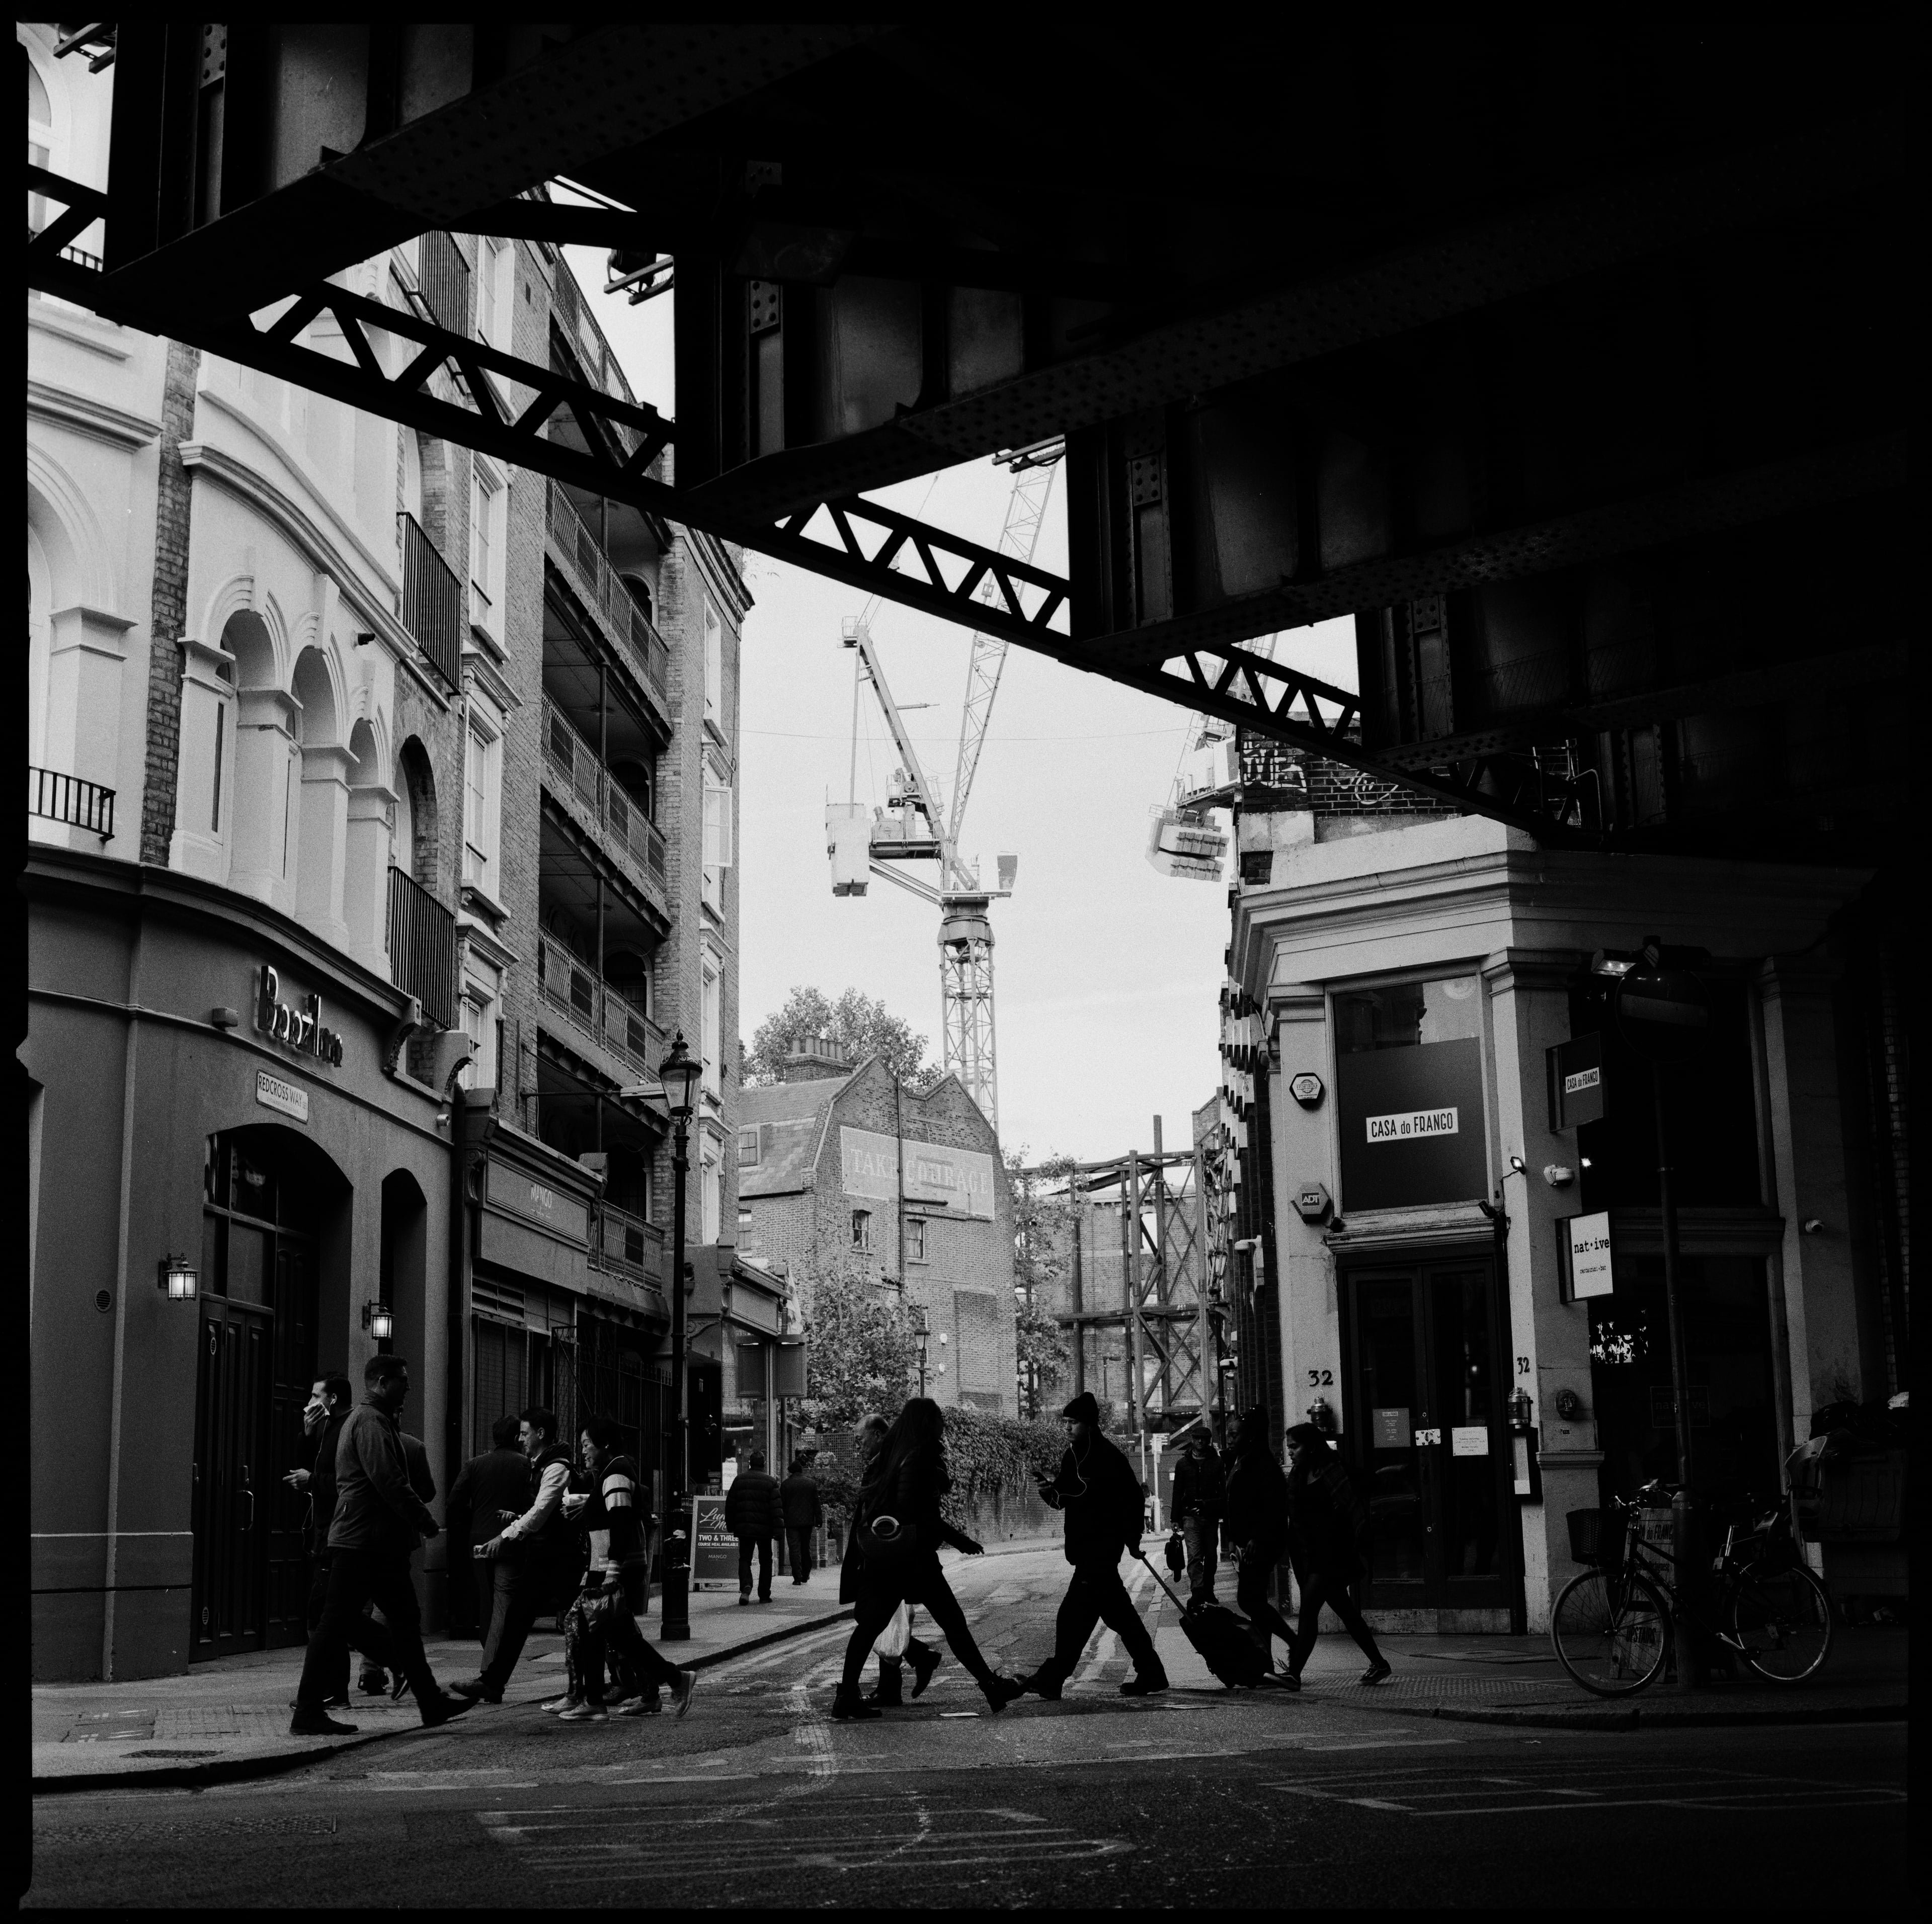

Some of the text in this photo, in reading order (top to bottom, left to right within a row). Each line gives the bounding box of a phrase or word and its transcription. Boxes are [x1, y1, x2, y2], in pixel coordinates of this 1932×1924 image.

[1567, 1070, 1598, 1090] CASA do FRANGO
[258, 1075, 288, 1101] REDCROSS
[289, 1089, 302, 1107] WAY
[1371, 1112, 1453, 1137] CASA do FRANGO
[850, 1148, 990, 1195] TAKE COURAGE
[531, 1184, 552, 1208] MANGO
[1302, 1195, 1320, 1204] ADT
[1517, 1357, 1530, 1374] 32
[1309, 1370, 1333, 1387] 32
[1654, 1524, 1674, 1540] FRANG
[1626, 1626, 1656, 1644] UPSTAIRS
